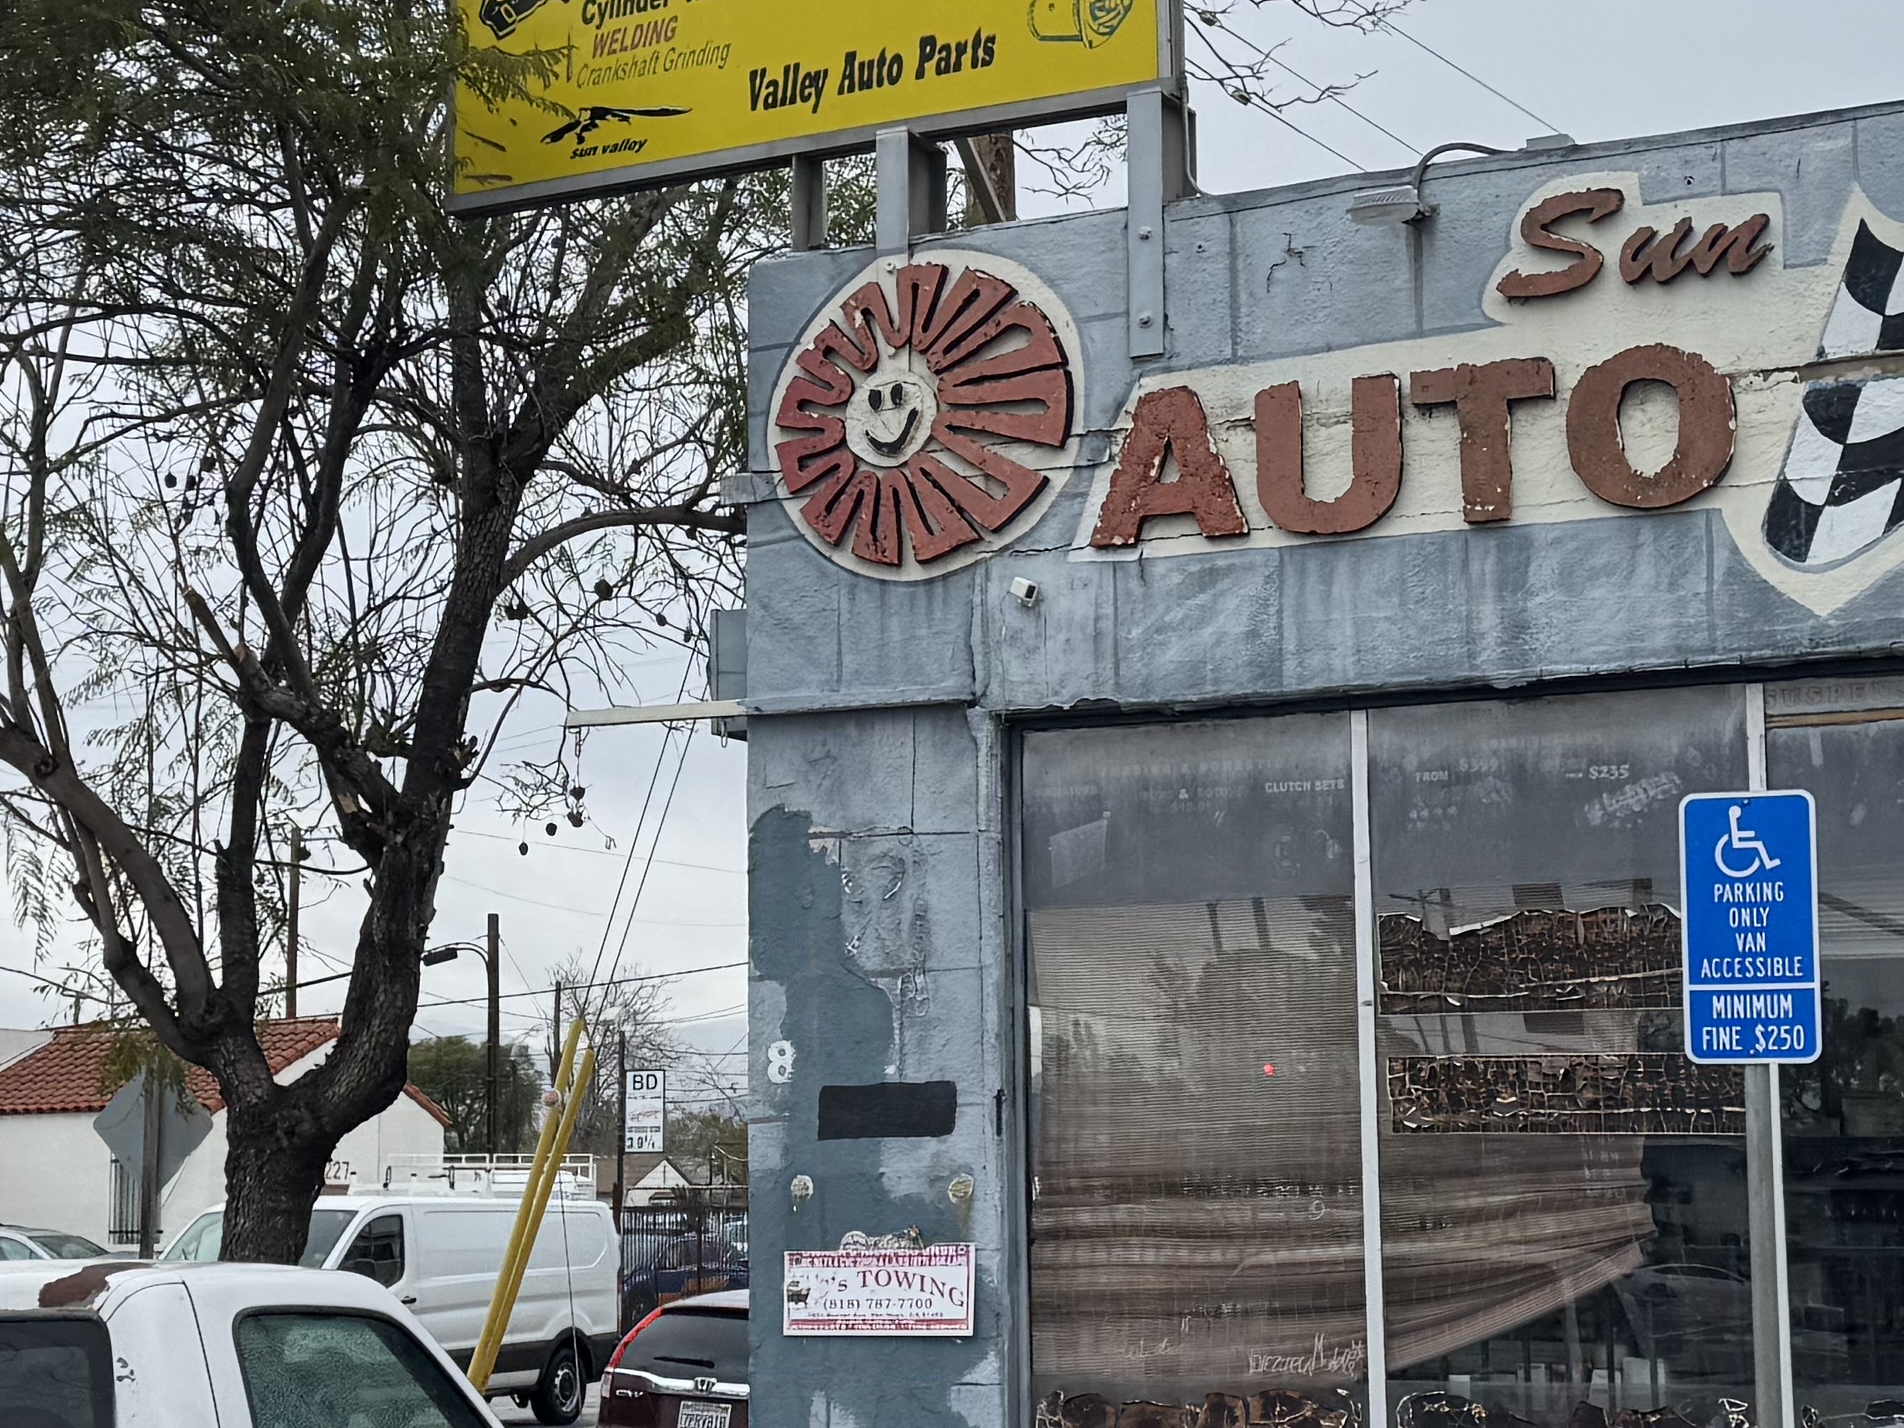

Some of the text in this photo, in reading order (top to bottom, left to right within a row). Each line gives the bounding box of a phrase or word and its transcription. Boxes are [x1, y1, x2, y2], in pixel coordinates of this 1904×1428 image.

[591, 15, 678, 60] WELDING
[576, 39, 733, 89] Crankshaft Grinding
[749, 26, 998, 115] Valley Auto Parts
[1495, 186, 1775, 300] Sun
[1091, 342, 1737, 549] AUTO
[1588, 764, 1630, 780] $235
[1265, 780, 1312, 793] CLUTCH
[1714, 881, 1784, 902] PARKING
[1729, 907, 1770, 927] ONLY
[1736, 933, 1766, 952] VAN
[1701, 957, 1803, 979] ACCESSIBLE
[1712, 994, 1793, 1019] MINIMUM
[1702, 1024, 1804, 1051] FINE $250
[633, 1074, 658, 1091] BD
[326, 1161, 350, 1180] 227
[856, 1269, 965, 1308] TOWING
[823, 1298, 933, 1311] (818) 787-7700
